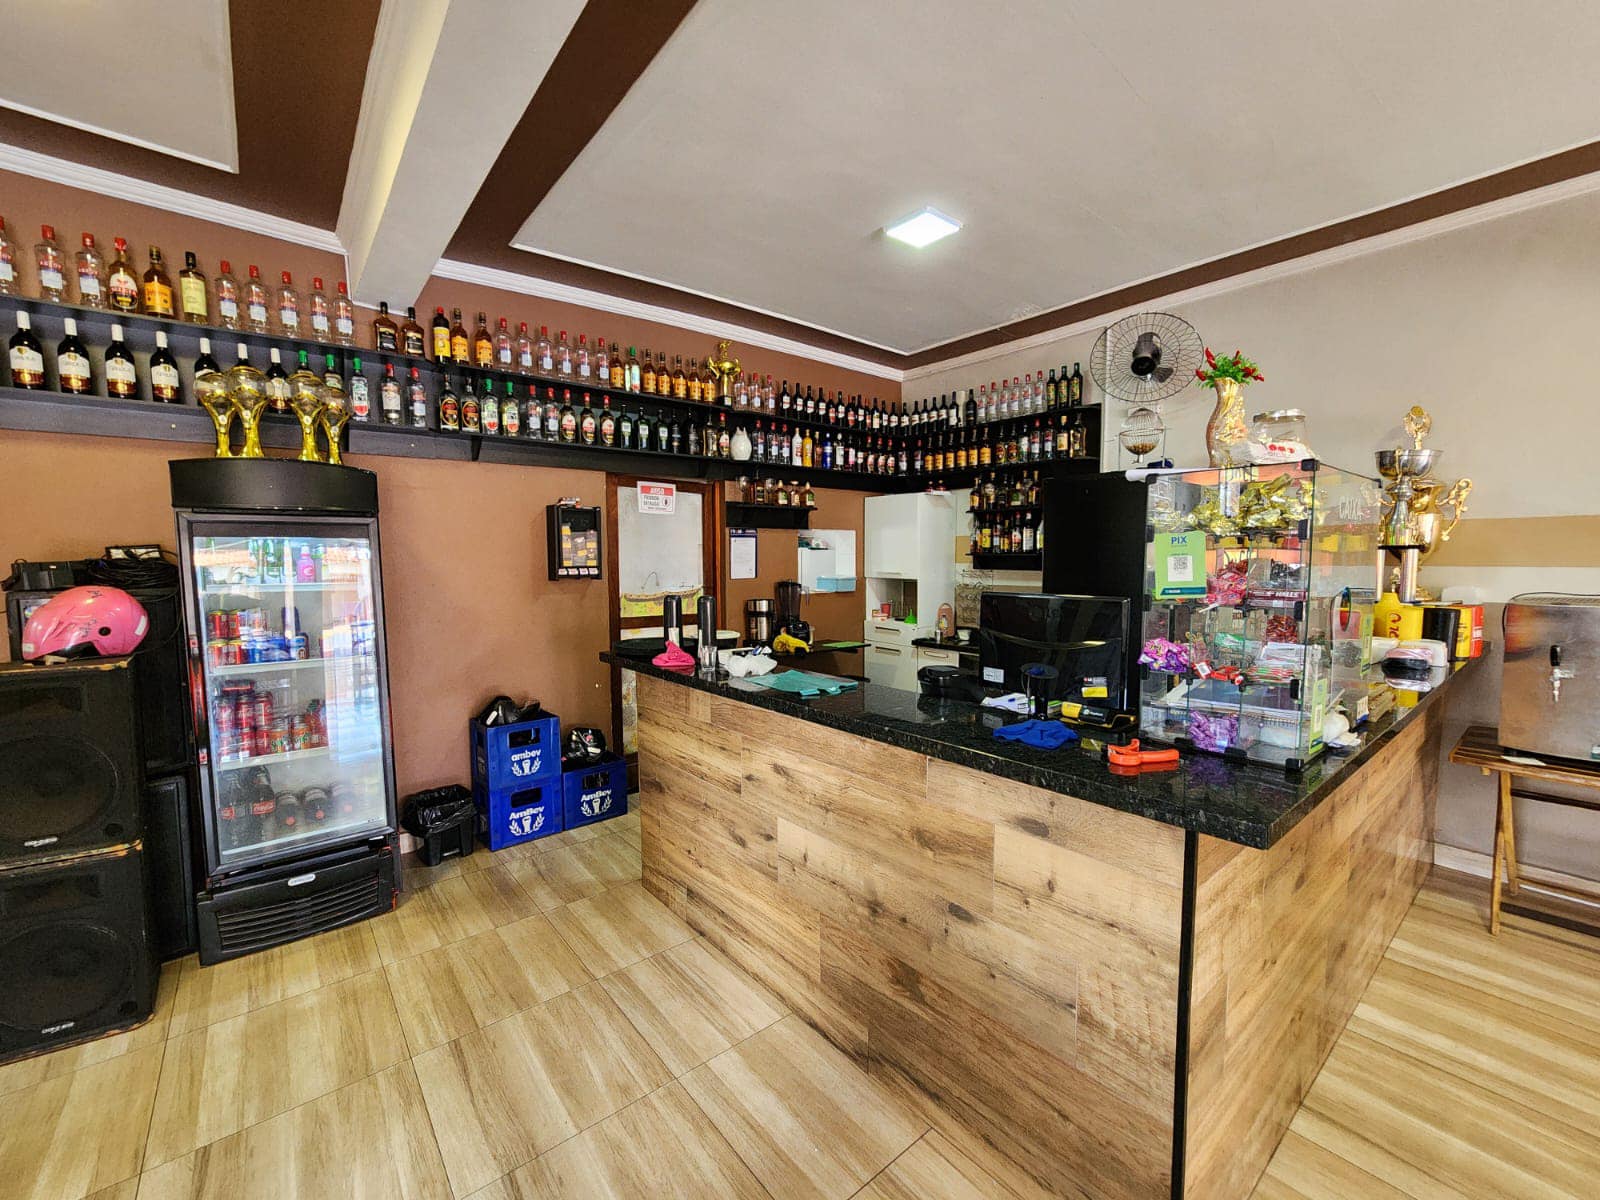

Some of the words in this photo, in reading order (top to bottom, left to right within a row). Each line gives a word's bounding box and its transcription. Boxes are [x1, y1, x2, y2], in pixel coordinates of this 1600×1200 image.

[1171, 536, 1187, 545] PIX
[511, 749, 541, 761] ambev
[580, 789, 612, 802] AmBev
[509, 806, 544, 821] AmBev
